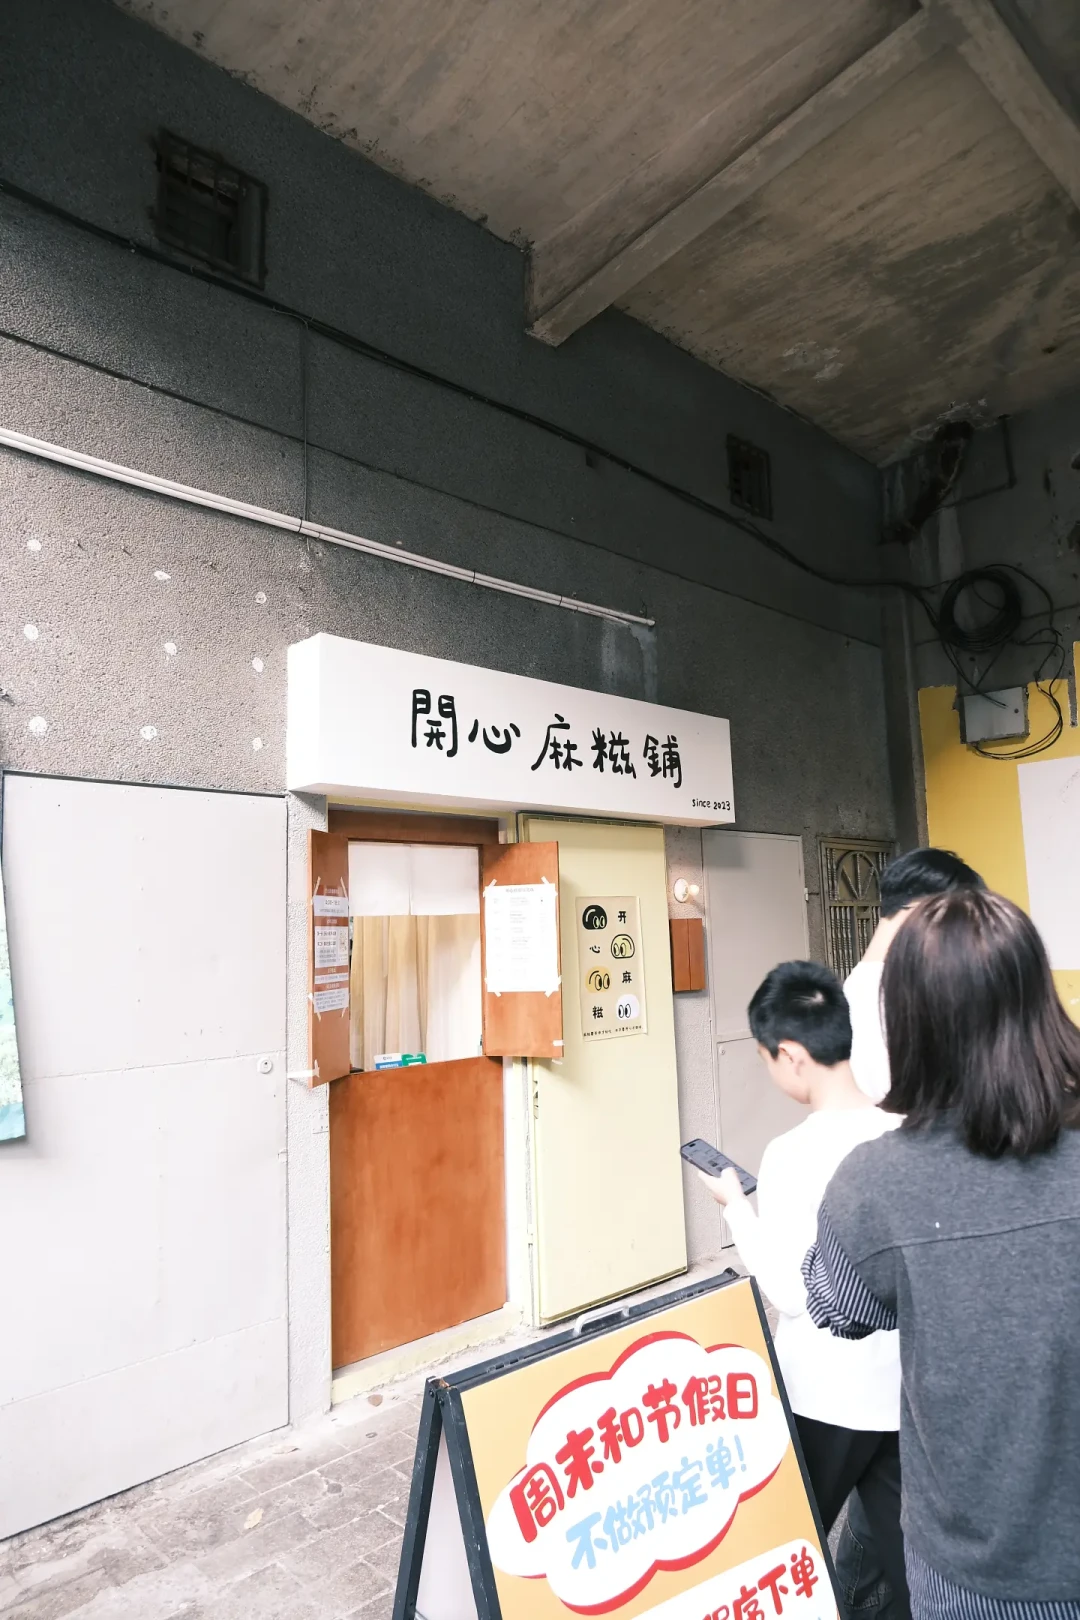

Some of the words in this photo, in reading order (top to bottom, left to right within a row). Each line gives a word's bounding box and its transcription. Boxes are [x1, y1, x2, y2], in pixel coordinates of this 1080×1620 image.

[411, 688, 682, 788] 開心麻糍鋪
[713, 801, 731, 811] 2023
[617, 910, 627, 924] 开
[589, 945, 601, 954] 心
[621, 970, 632, 984] 麻
[509, 1372, 758, 1543] 周末和节假日
[702, 1546, 819, 1620] 序下单
